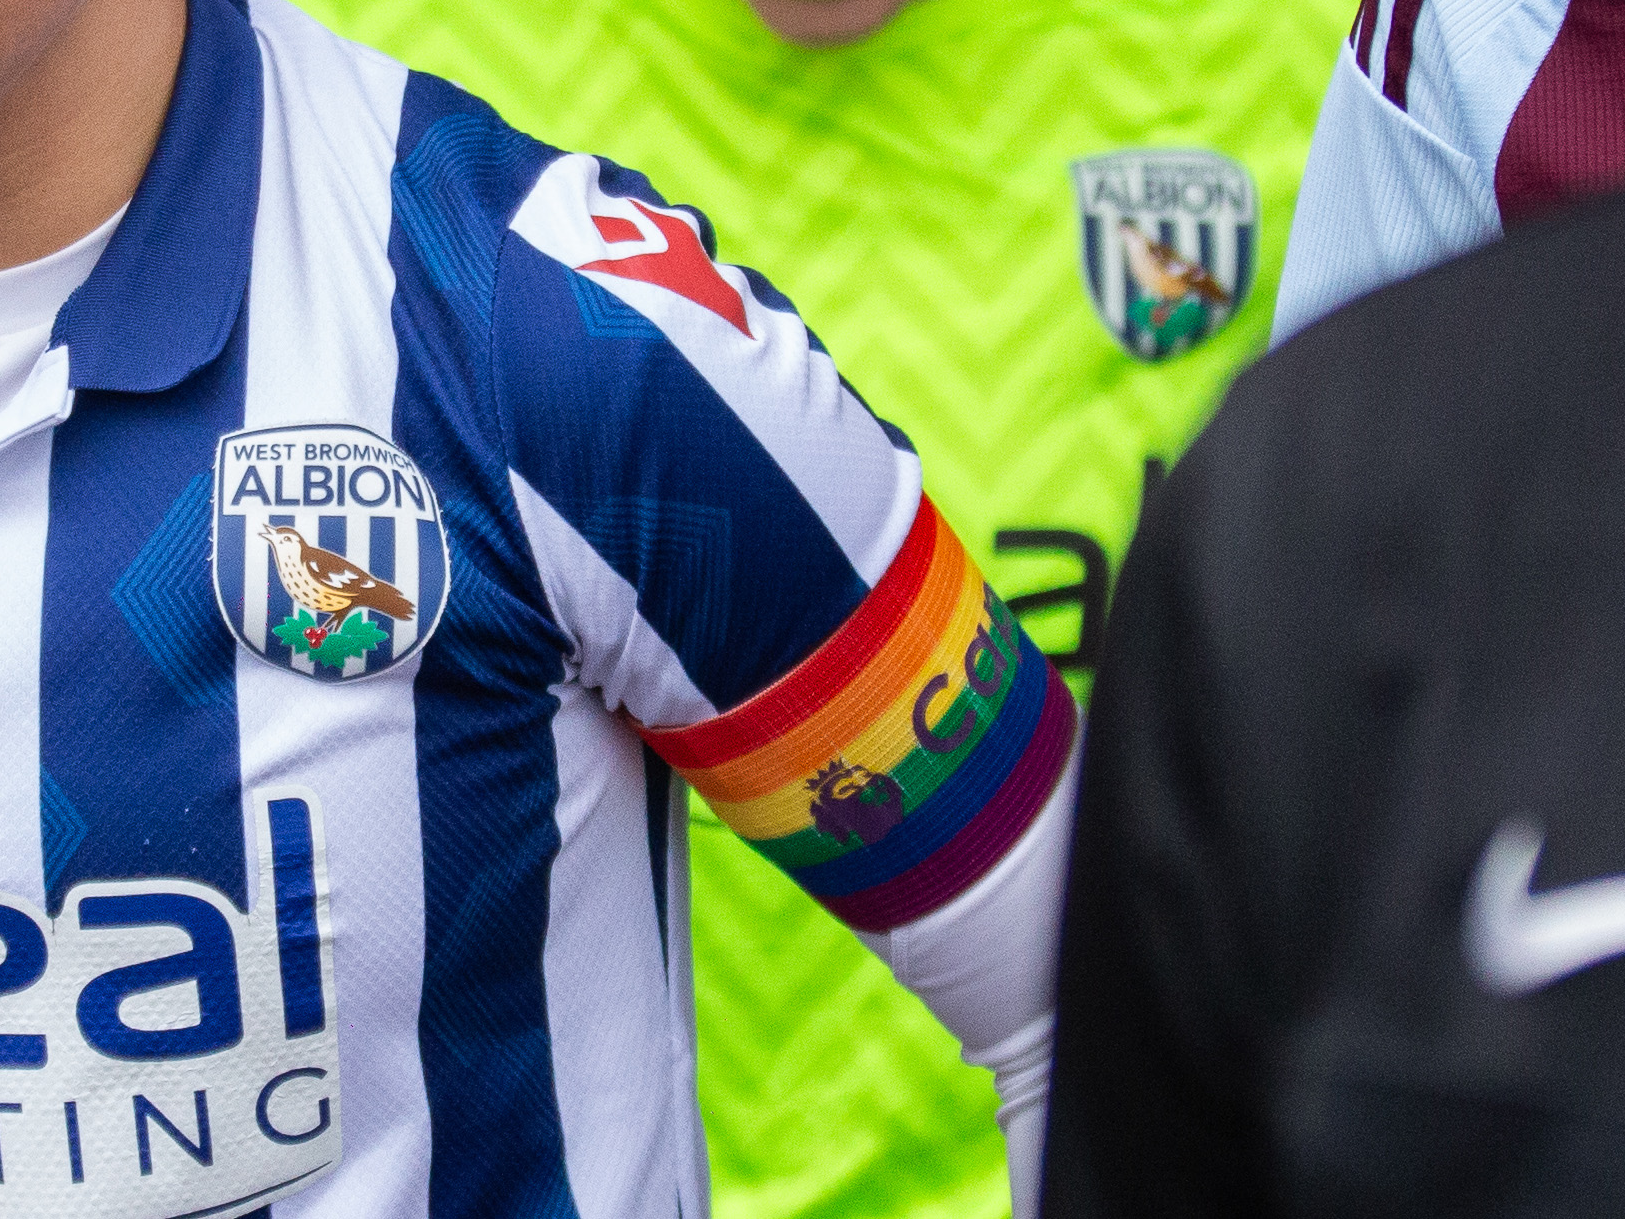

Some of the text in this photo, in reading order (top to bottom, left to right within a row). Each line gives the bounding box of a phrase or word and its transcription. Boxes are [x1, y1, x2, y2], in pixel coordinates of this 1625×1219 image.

[1081, 169, 1248, 218] ALBION
[233, 443, 416, 474] WEST BROMWICH
[230, 464, 427, 512] ALBION
